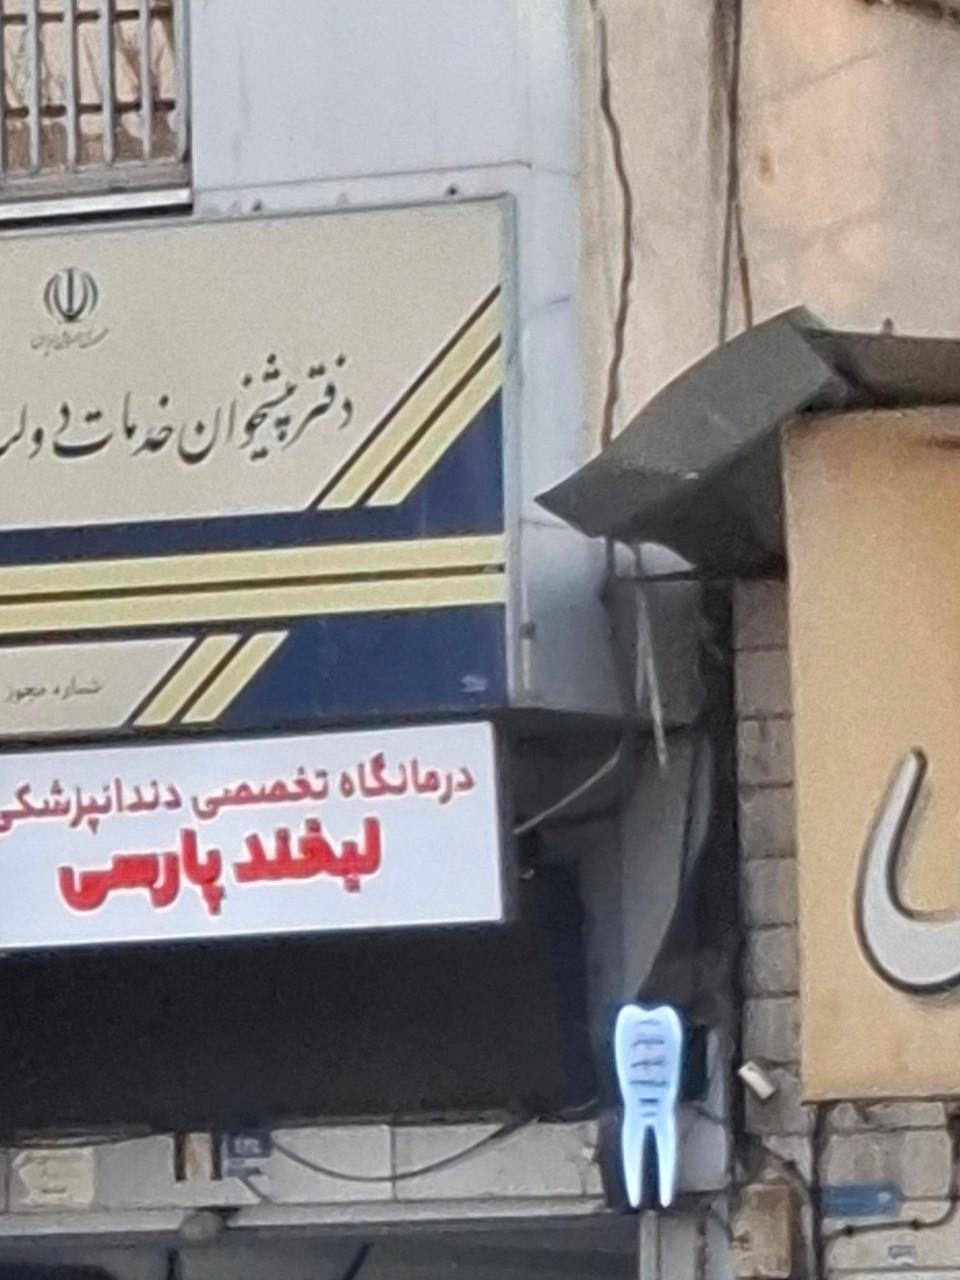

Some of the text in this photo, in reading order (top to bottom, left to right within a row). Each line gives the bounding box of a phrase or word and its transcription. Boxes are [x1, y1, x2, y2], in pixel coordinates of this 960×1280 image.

[51, 390, 174, 458] خدمات
[177, 352, 296, 465] پیشخوان
[283, 352, 355, 451] دفتر
[4, 682, 48, 706] مجوز
[52, 674, 104, 702] شماره
[191, 765, 329, 821] تخصصی
[338, 751, 475, 805] درمانگاه
[58, 816, 382, 915] لبخند پارسی
